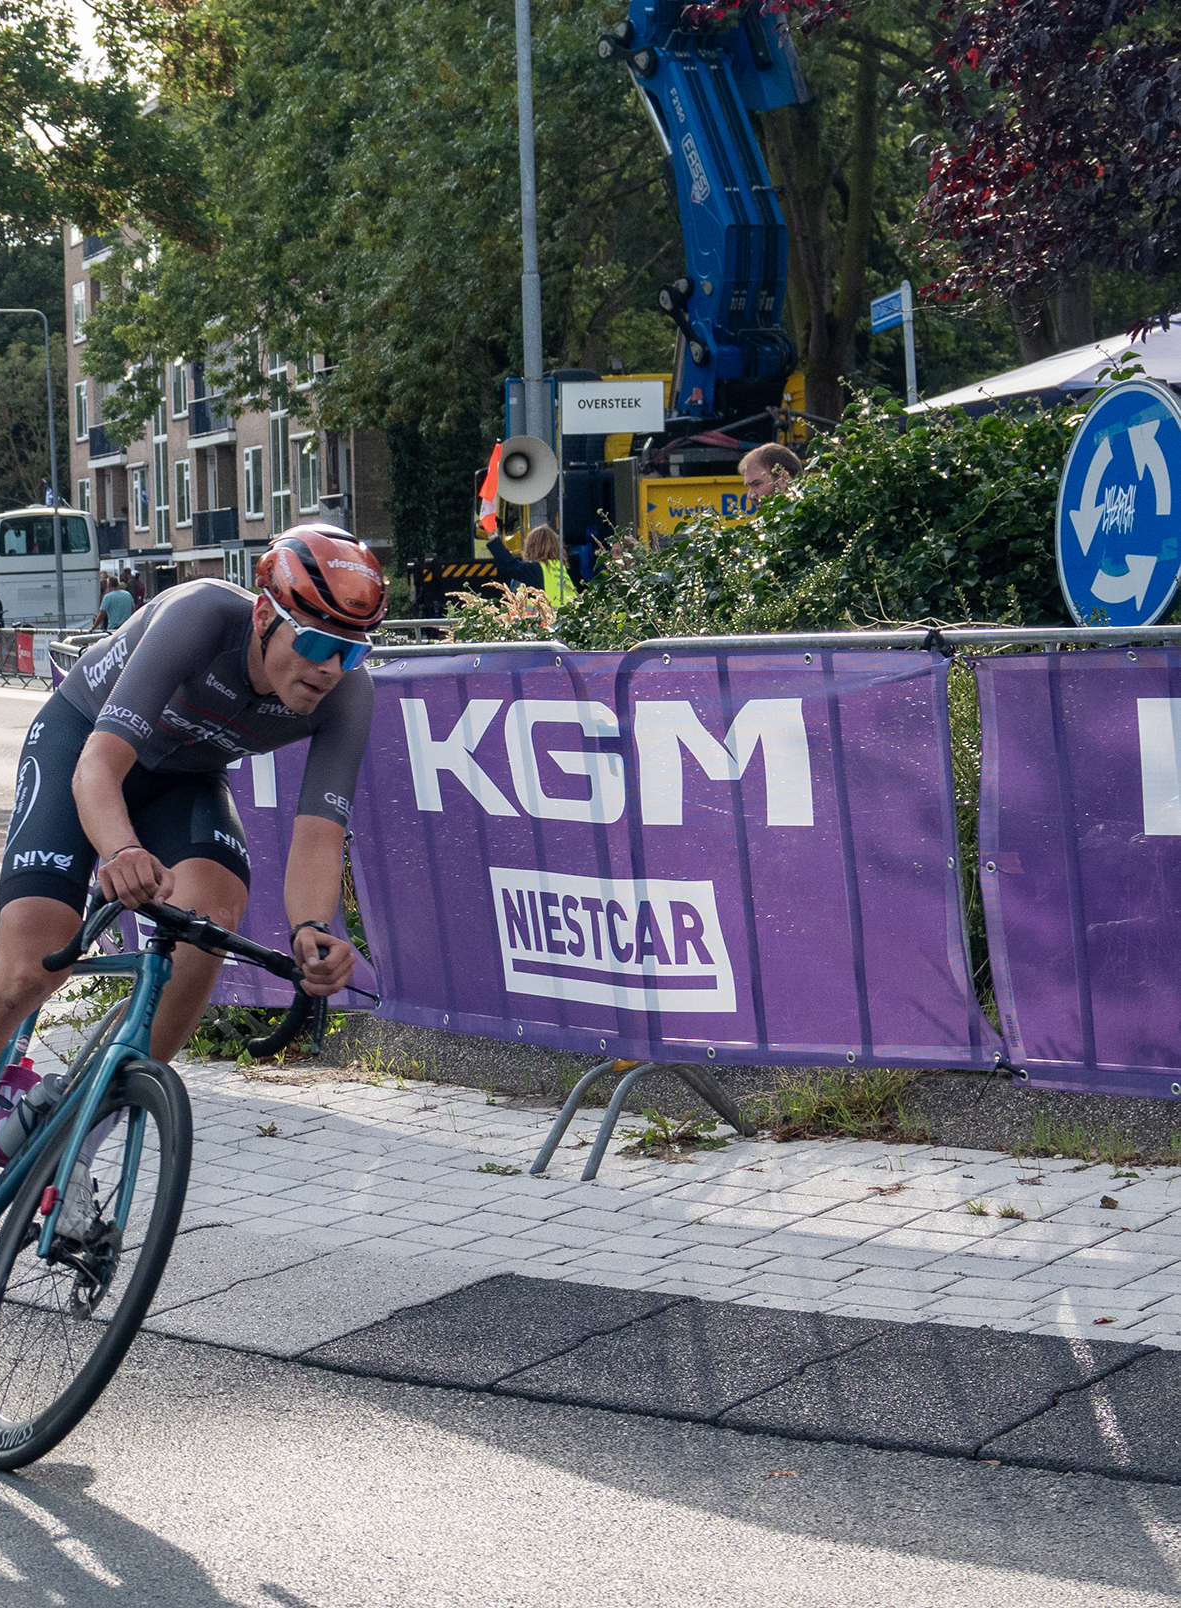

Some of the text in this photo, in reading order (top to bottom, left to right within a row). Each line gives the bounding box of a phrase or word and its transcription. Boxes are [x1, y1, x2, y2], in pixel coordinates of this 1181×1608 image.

[578, 398, 642, 409] OVERSTEEK
[399, 698, 815, 826] KGM
[502, 888, 713, 966] NIESTCAR
